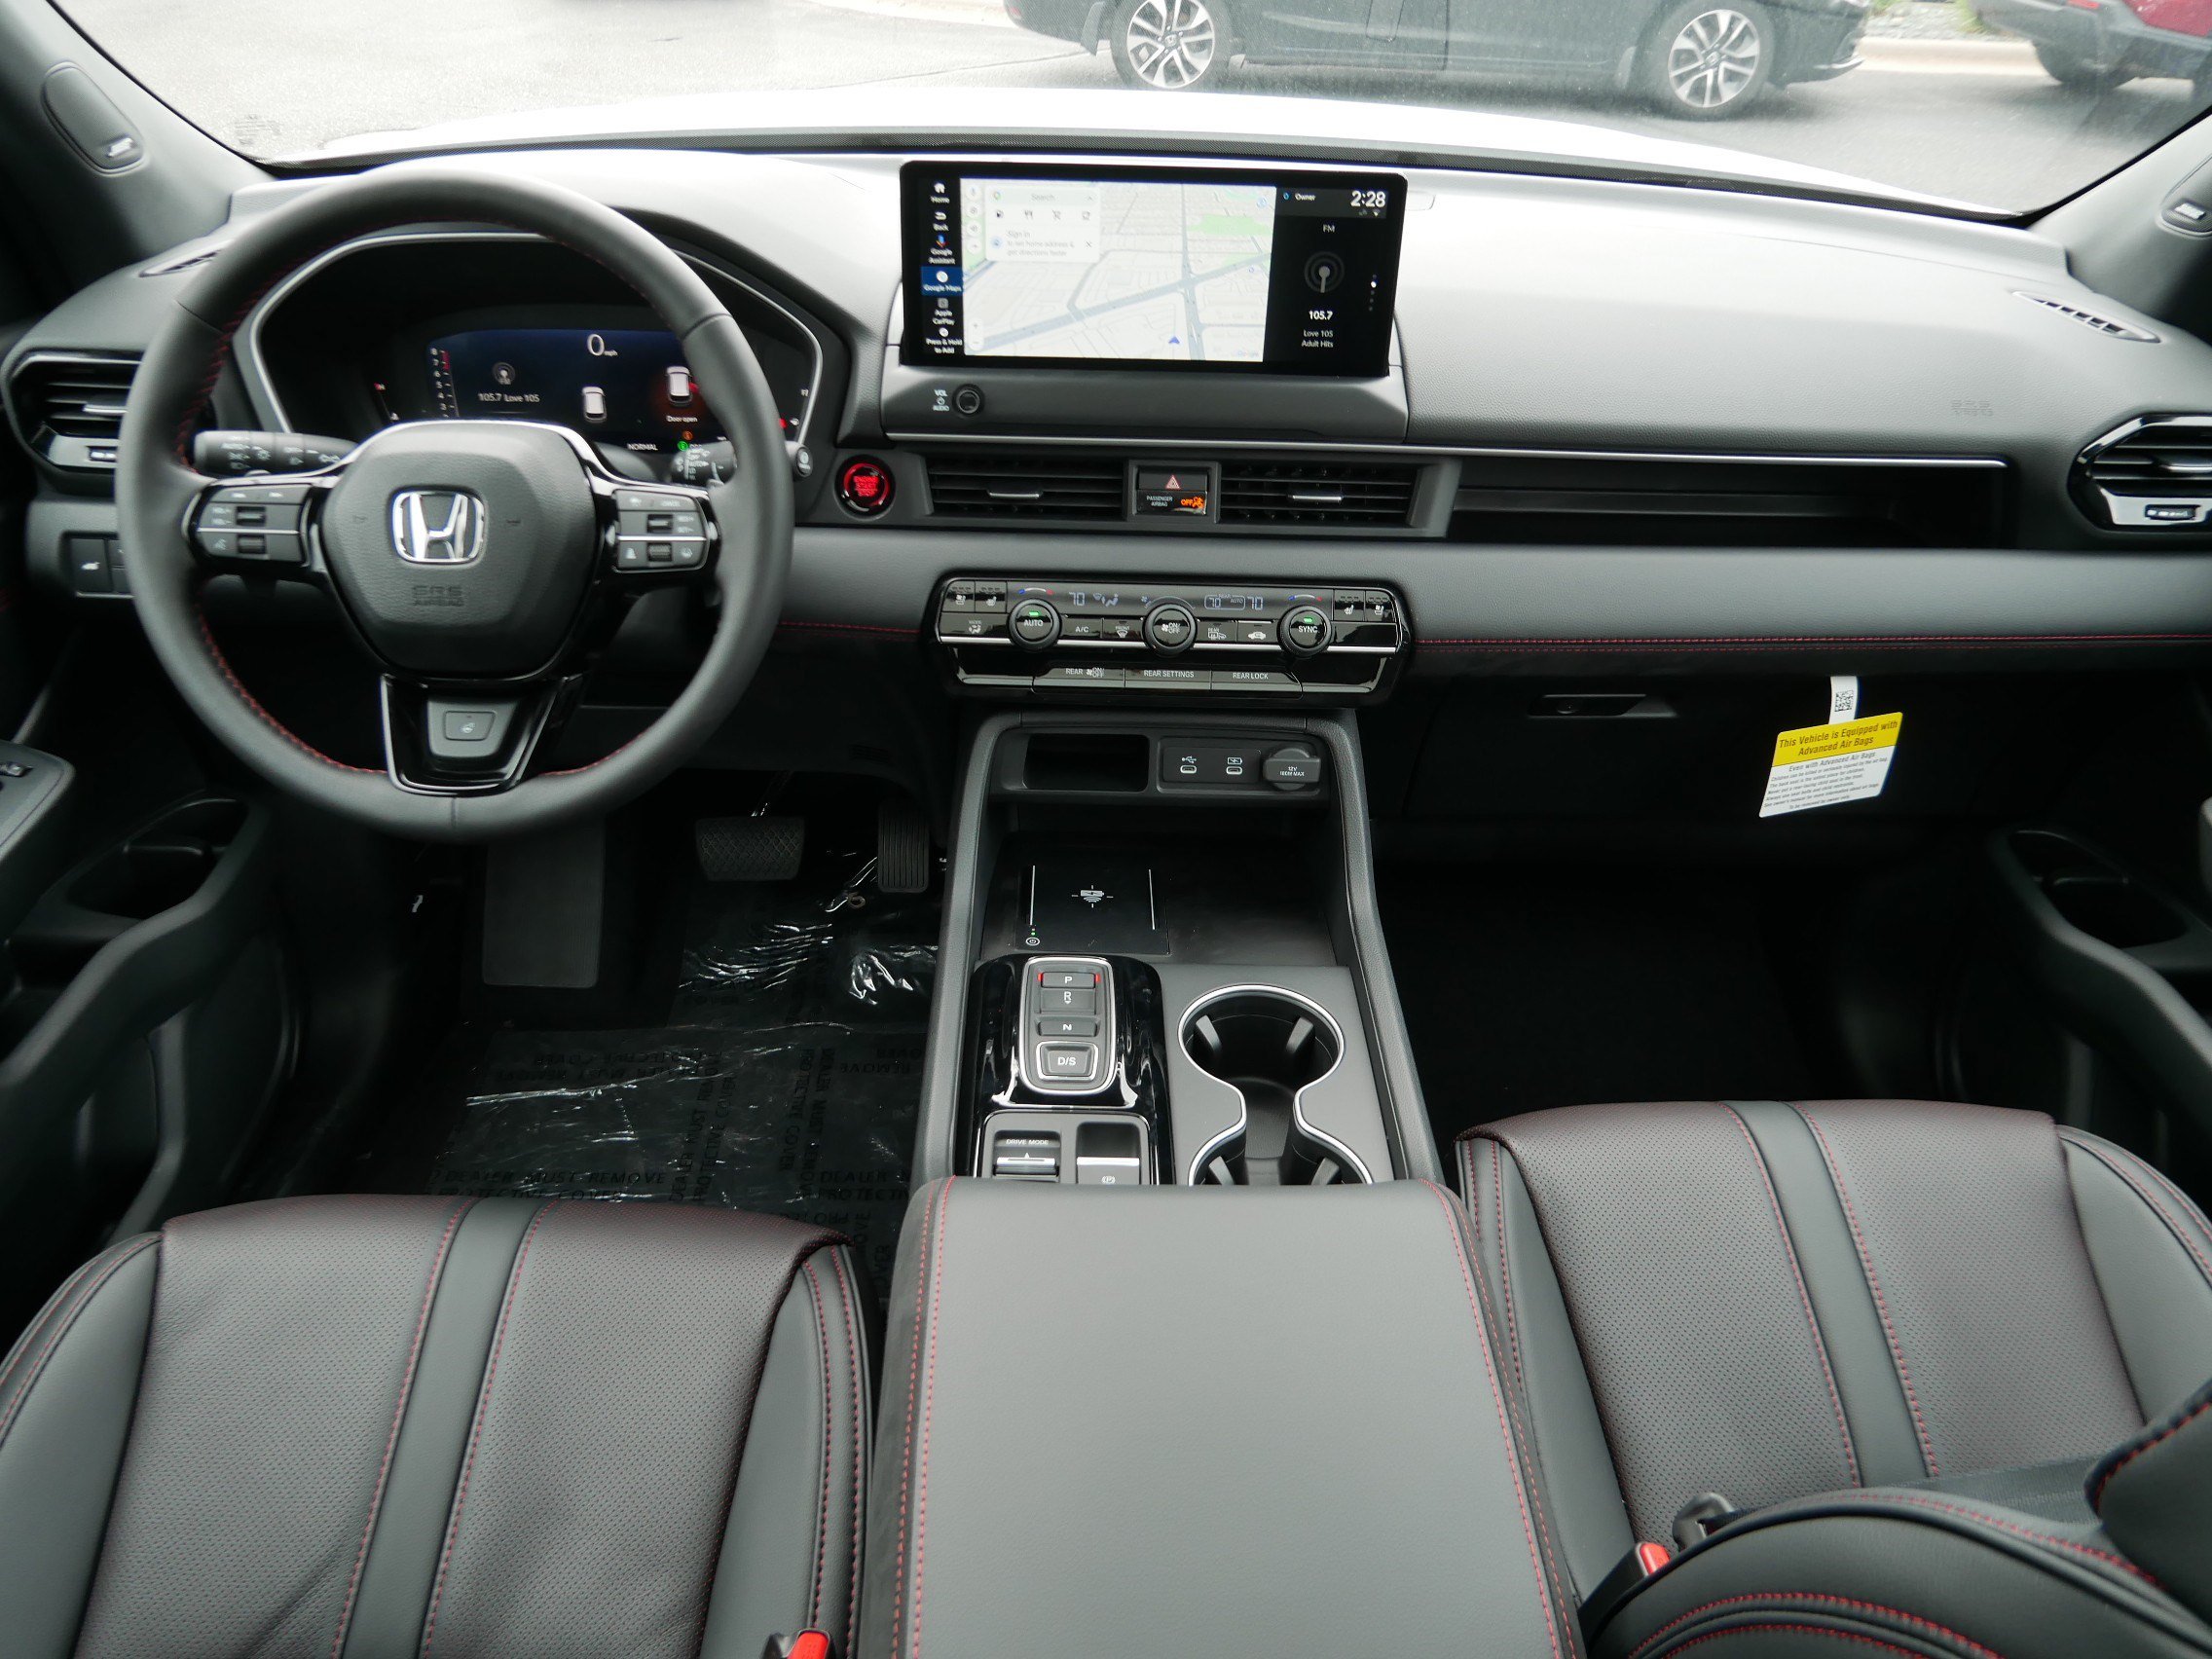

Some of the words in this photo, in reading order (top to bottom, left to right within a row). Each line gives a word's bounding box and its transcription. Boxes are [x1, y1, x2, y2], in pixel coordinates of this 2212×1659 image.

[1350, 191, 1386, 207] 2:28
[1323, 224, 1335, 233] FM
[1309, 311, 1333, 320] 105.7
[587, 334, 605, 356] 0
[478, 392, 501, 401] 105.7
[504, 393, 523, 402] Love
[525, 393, 539, 402] 105
[1069, 592, 1085, 606] 70
[1209, 598, 1221, 608] 70
[1247, 597, 1263, 610] 70
[1779, 738, 1796, 748] This
[1799, 732, 1829, 745] Vehicle
[1831, 731, 1839, 740] is
[1841, 723, 1879, 737] Equipped
[1881, 720, 1898, 730] with
[1798, 742, 1838, 756] Advanced
[1840, 740, 1853, 749] Air
[1854, 737, 1874, 747] Bags
[1064, 991, 1072, 1001] R
[590, 1172, 665, 1184] REMOVE
[821, 1170, 888, 1183] DEALER
